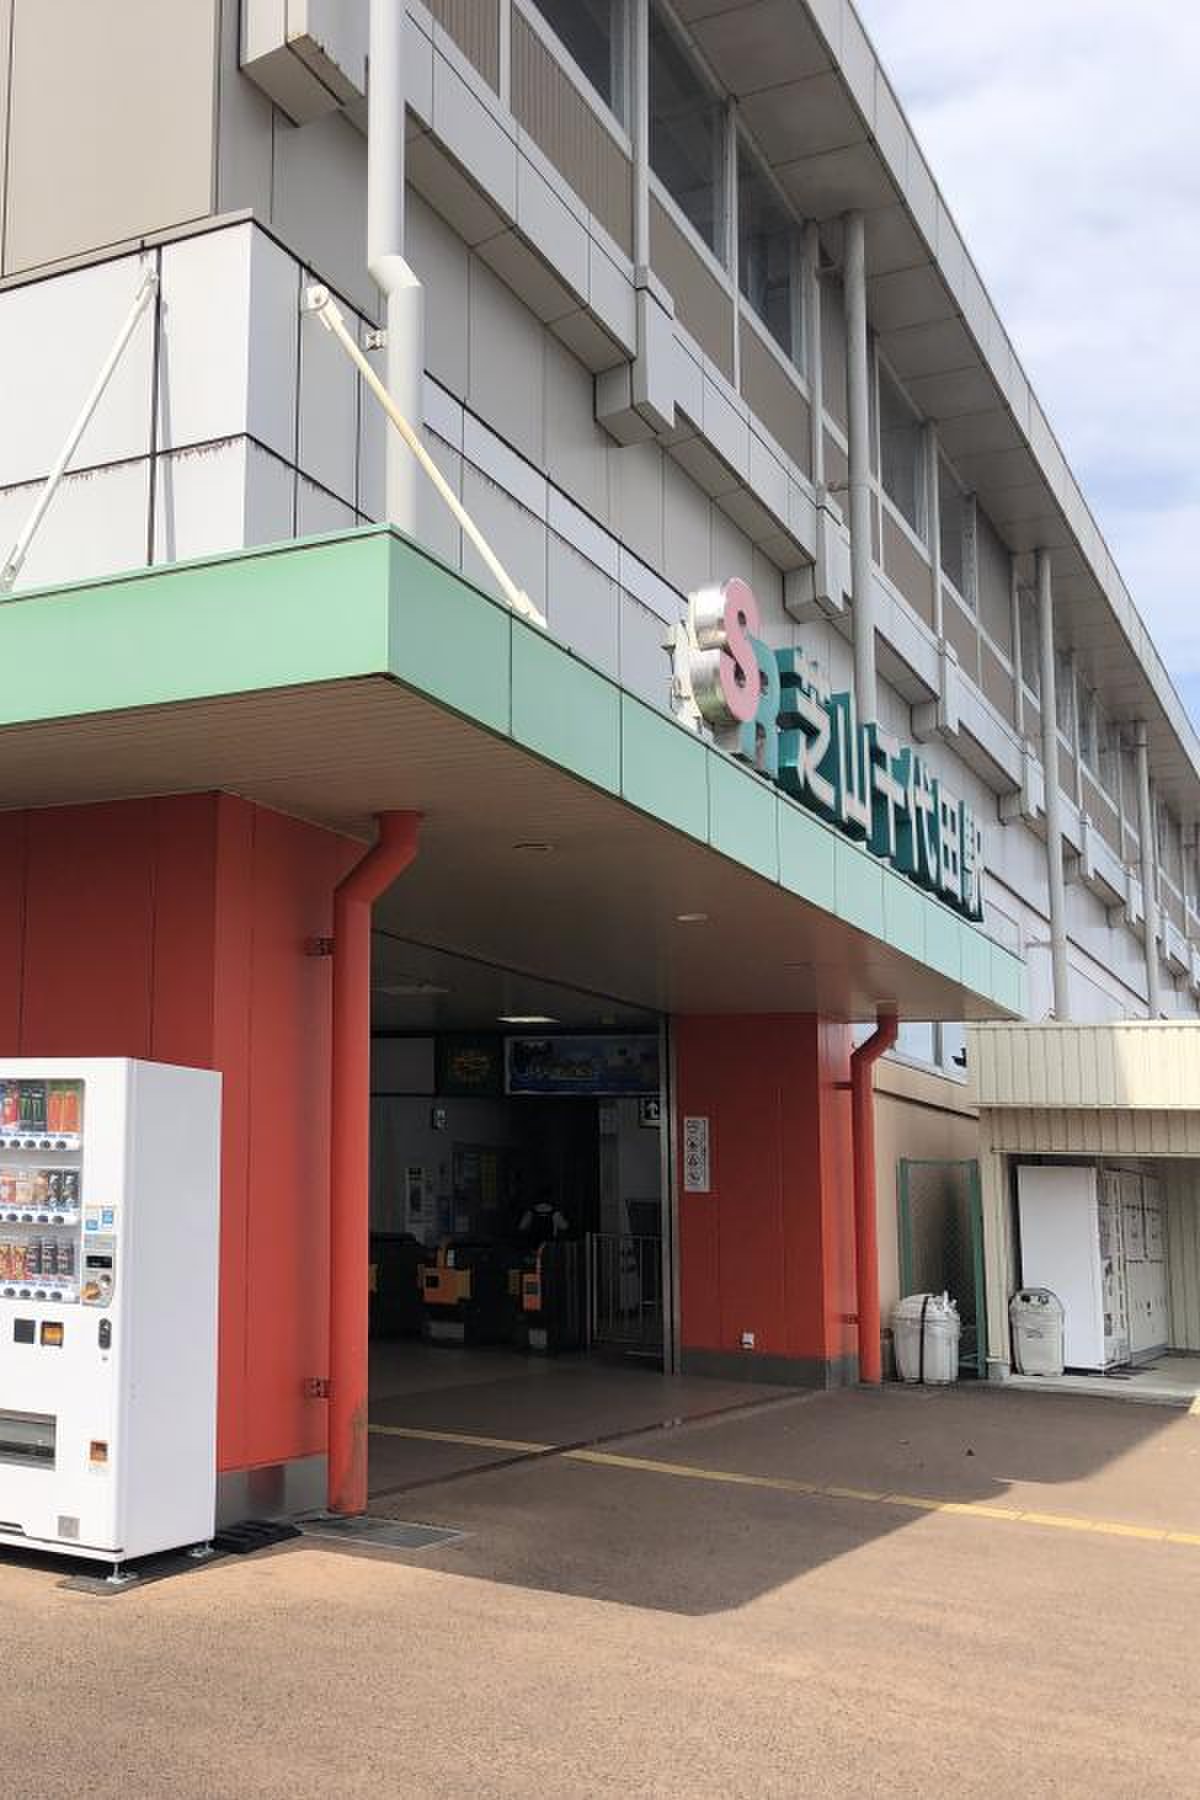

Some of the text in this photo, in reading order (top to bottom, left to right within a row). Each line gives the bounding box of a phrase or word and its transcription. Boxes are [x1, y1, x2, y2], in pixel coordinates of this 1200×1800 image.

[778, 647, 984, 922] 芝山千代田駅
